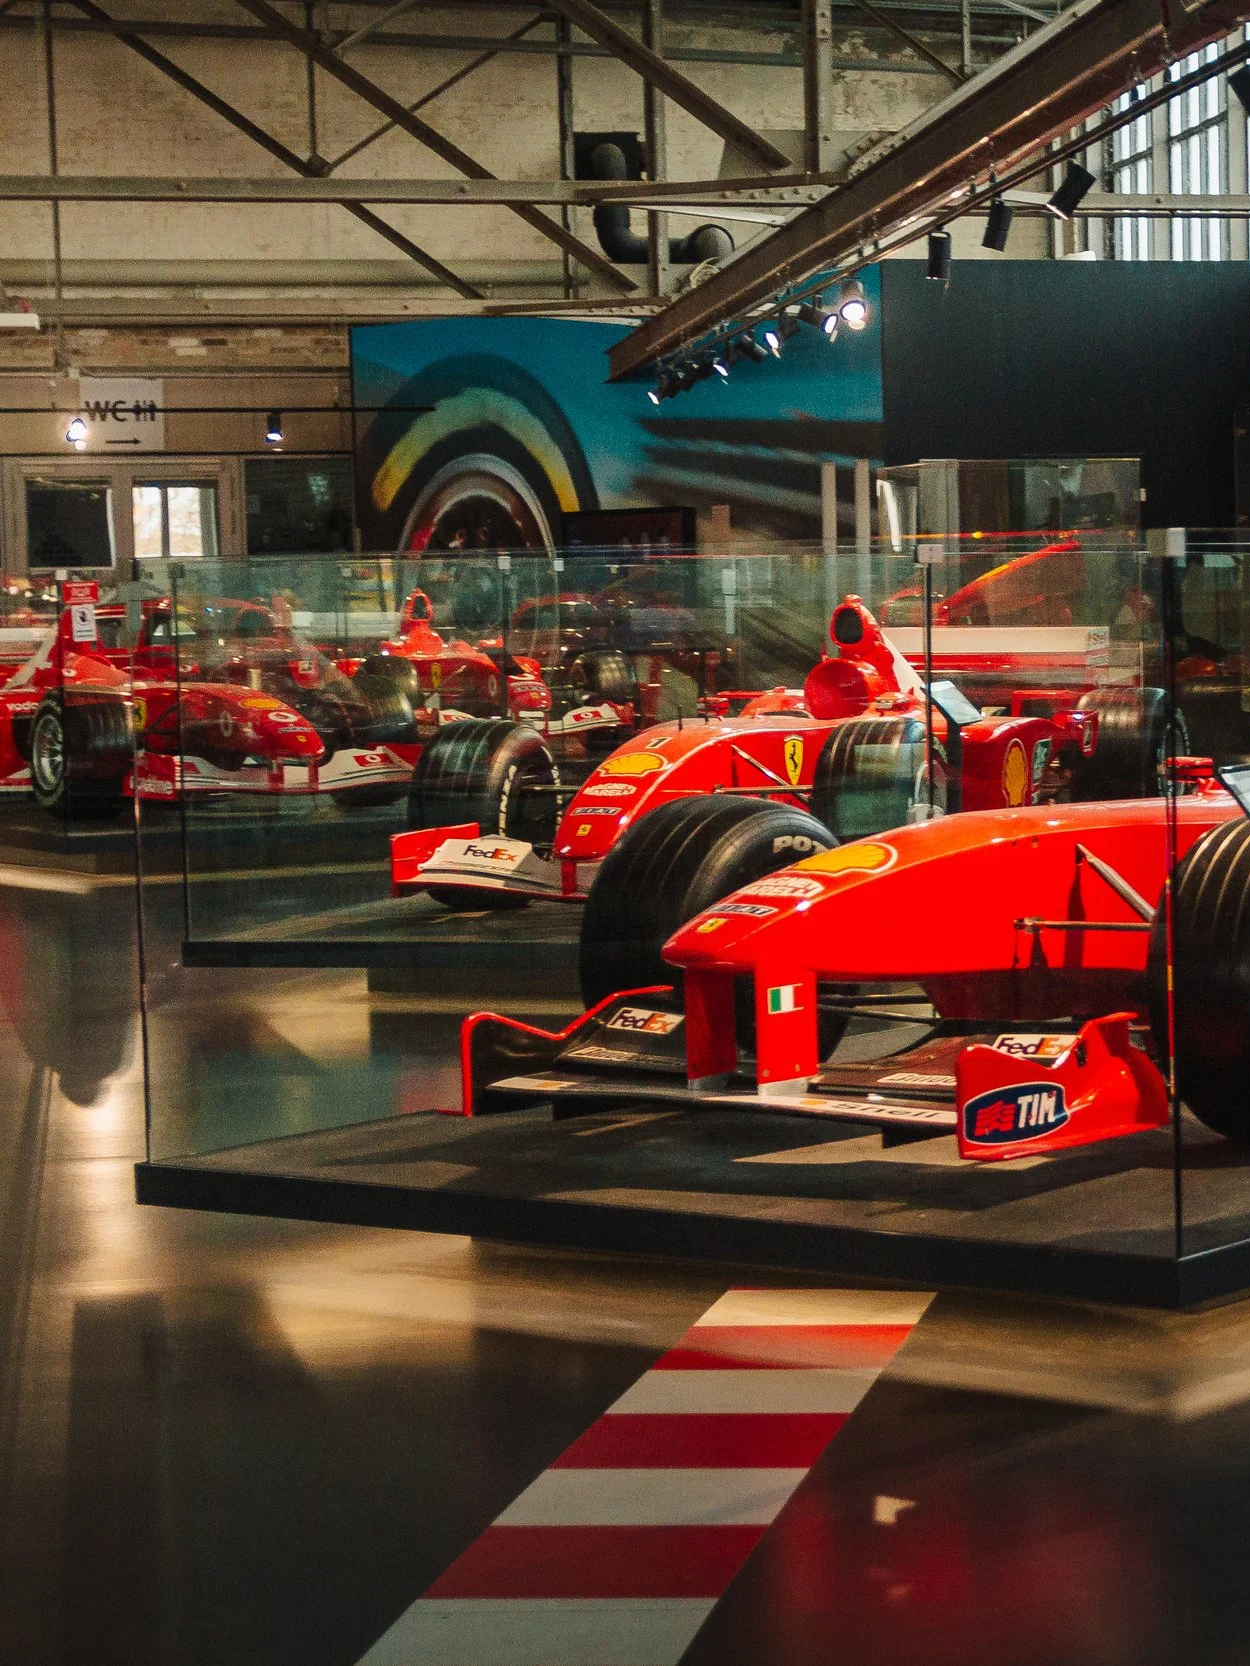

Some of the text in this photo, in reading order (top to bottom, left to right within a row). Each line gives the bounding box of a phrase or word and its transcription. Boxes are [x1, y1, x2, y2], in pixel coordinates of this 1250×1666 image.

[84, 400, 127, 422] WC
[645, 737, 672, 749] 1
[463, 844, 519, 863] FedEx
[613, 1009, 674, 1033] FedEx
[832, 1102, 941, 1119] Shell
[1017, 1090, 1057, 1128] TIM
